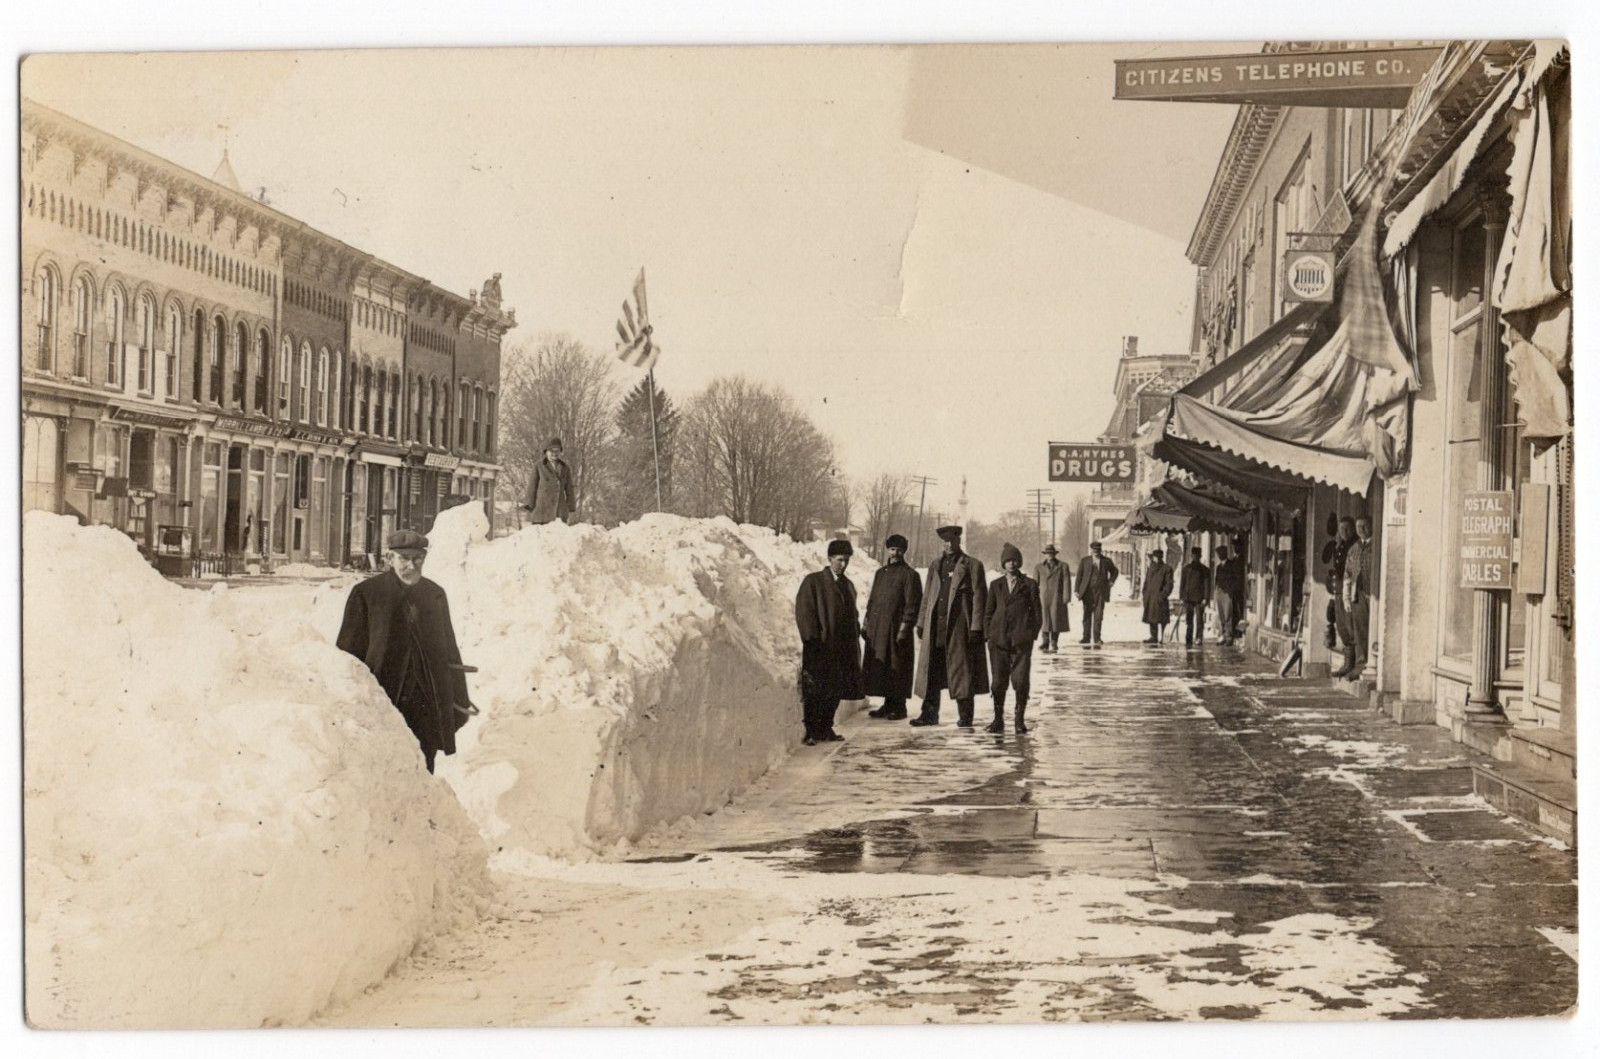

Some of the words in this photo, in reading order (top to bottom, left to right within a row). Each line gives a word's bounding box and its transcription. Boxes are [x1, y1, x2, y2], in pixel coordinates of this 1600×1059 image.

[1125, 65, 1223, 87] CITIZENS
[1235, 59, 1366, 82] TELEPHONE
[1375, 59, 1412, 76] CO.
[1051, 459, 1132, 478] DRUGS
